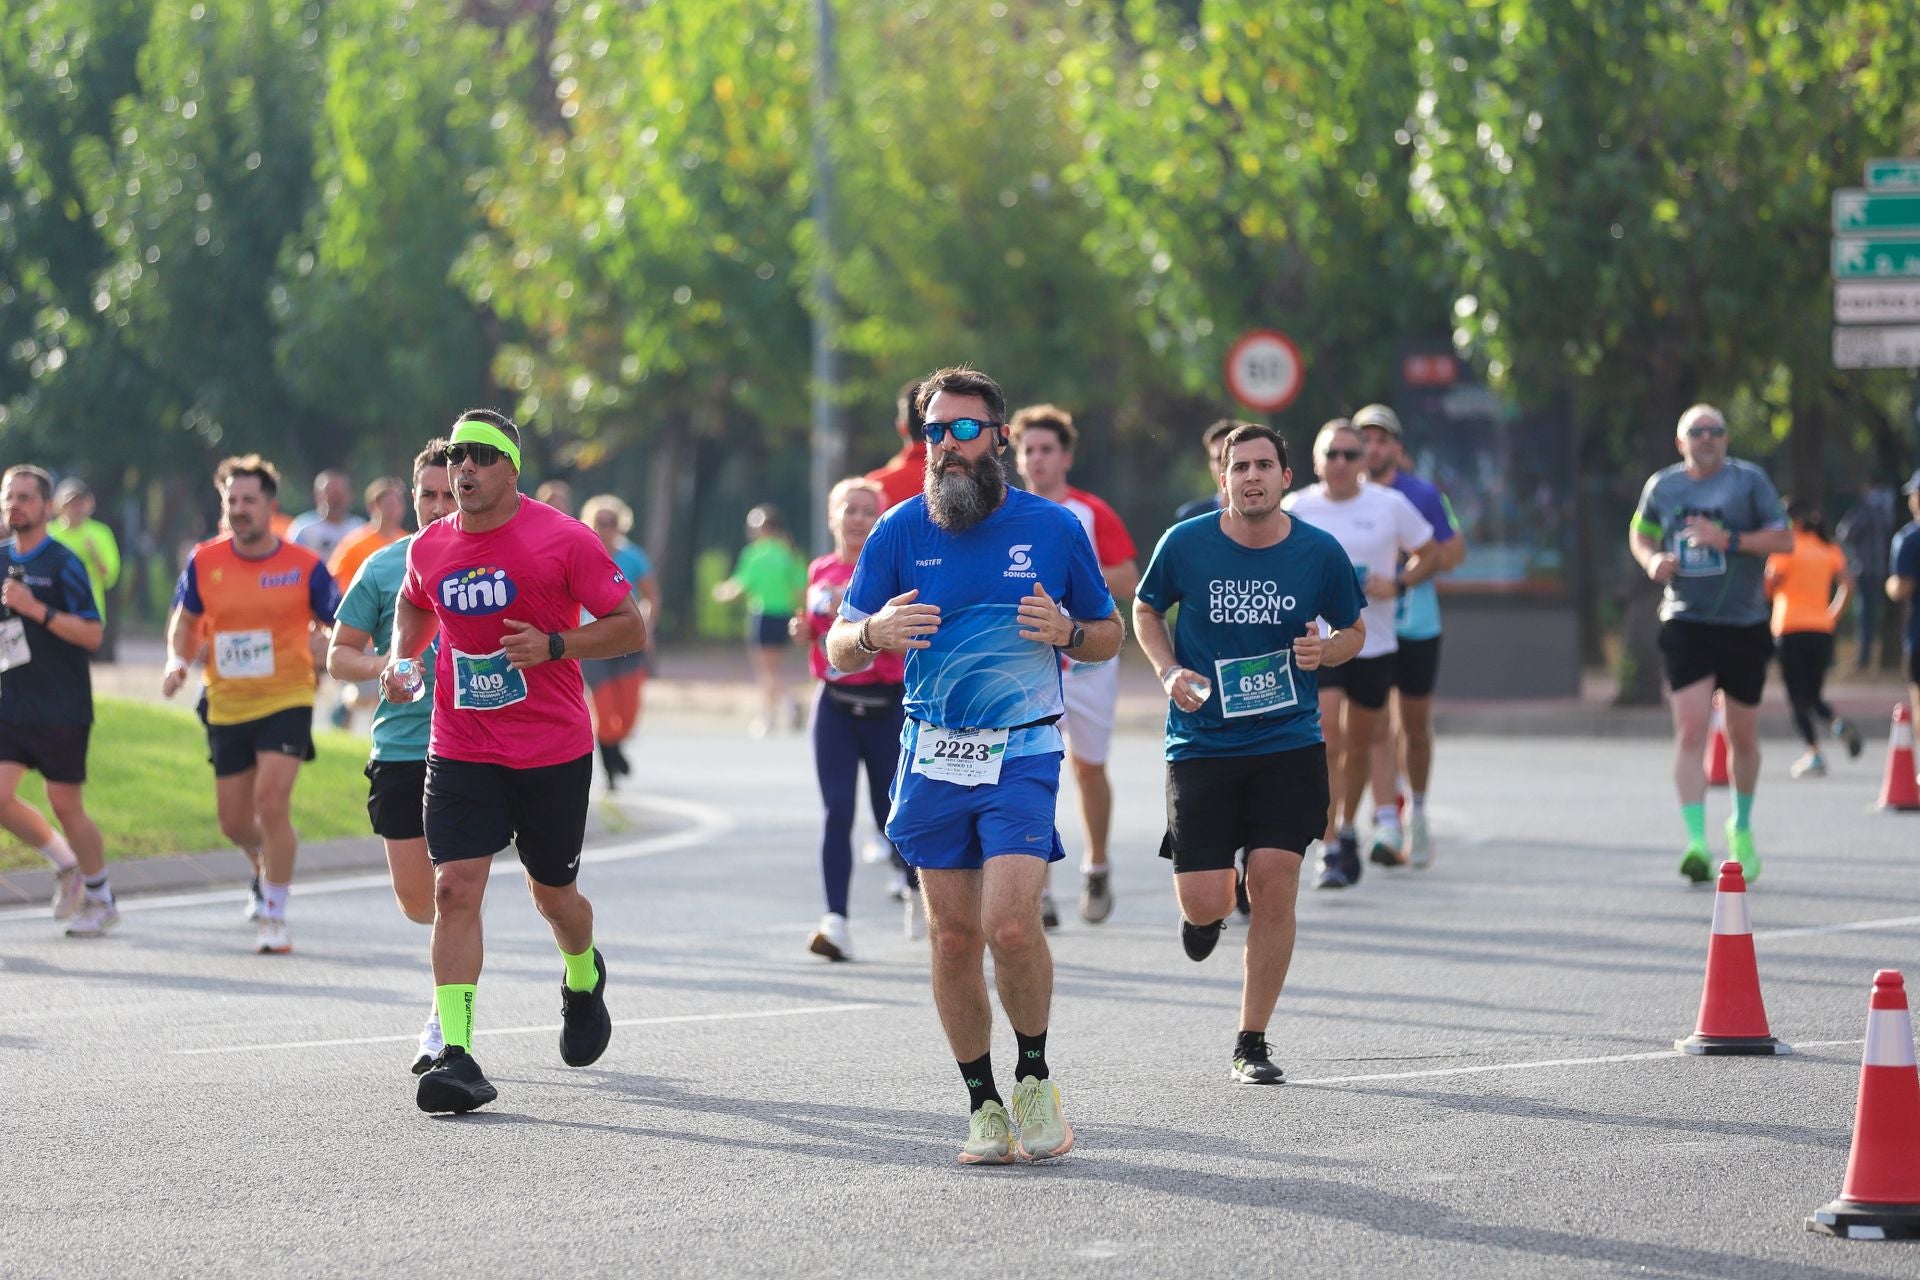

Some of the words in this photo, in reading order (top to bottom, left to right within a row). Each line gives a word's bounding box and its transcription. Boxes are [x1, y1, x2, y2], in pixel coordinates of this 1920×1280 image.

[915, 558, 943, 567] FASTER
[1003, 570, 1037, 579] SONOCO
[443, 569, 507, 611] Fini
[1209, 579, 1277, 595] GRUPO
[1210, 594, 1296, 611] HOZONO
[1209, 608, 1281, 624] GLOBAL
[469, 673, 504, 691] 409
[1239, 671, 1276, 693] 638
[934, 740, 990, 762] 2223
